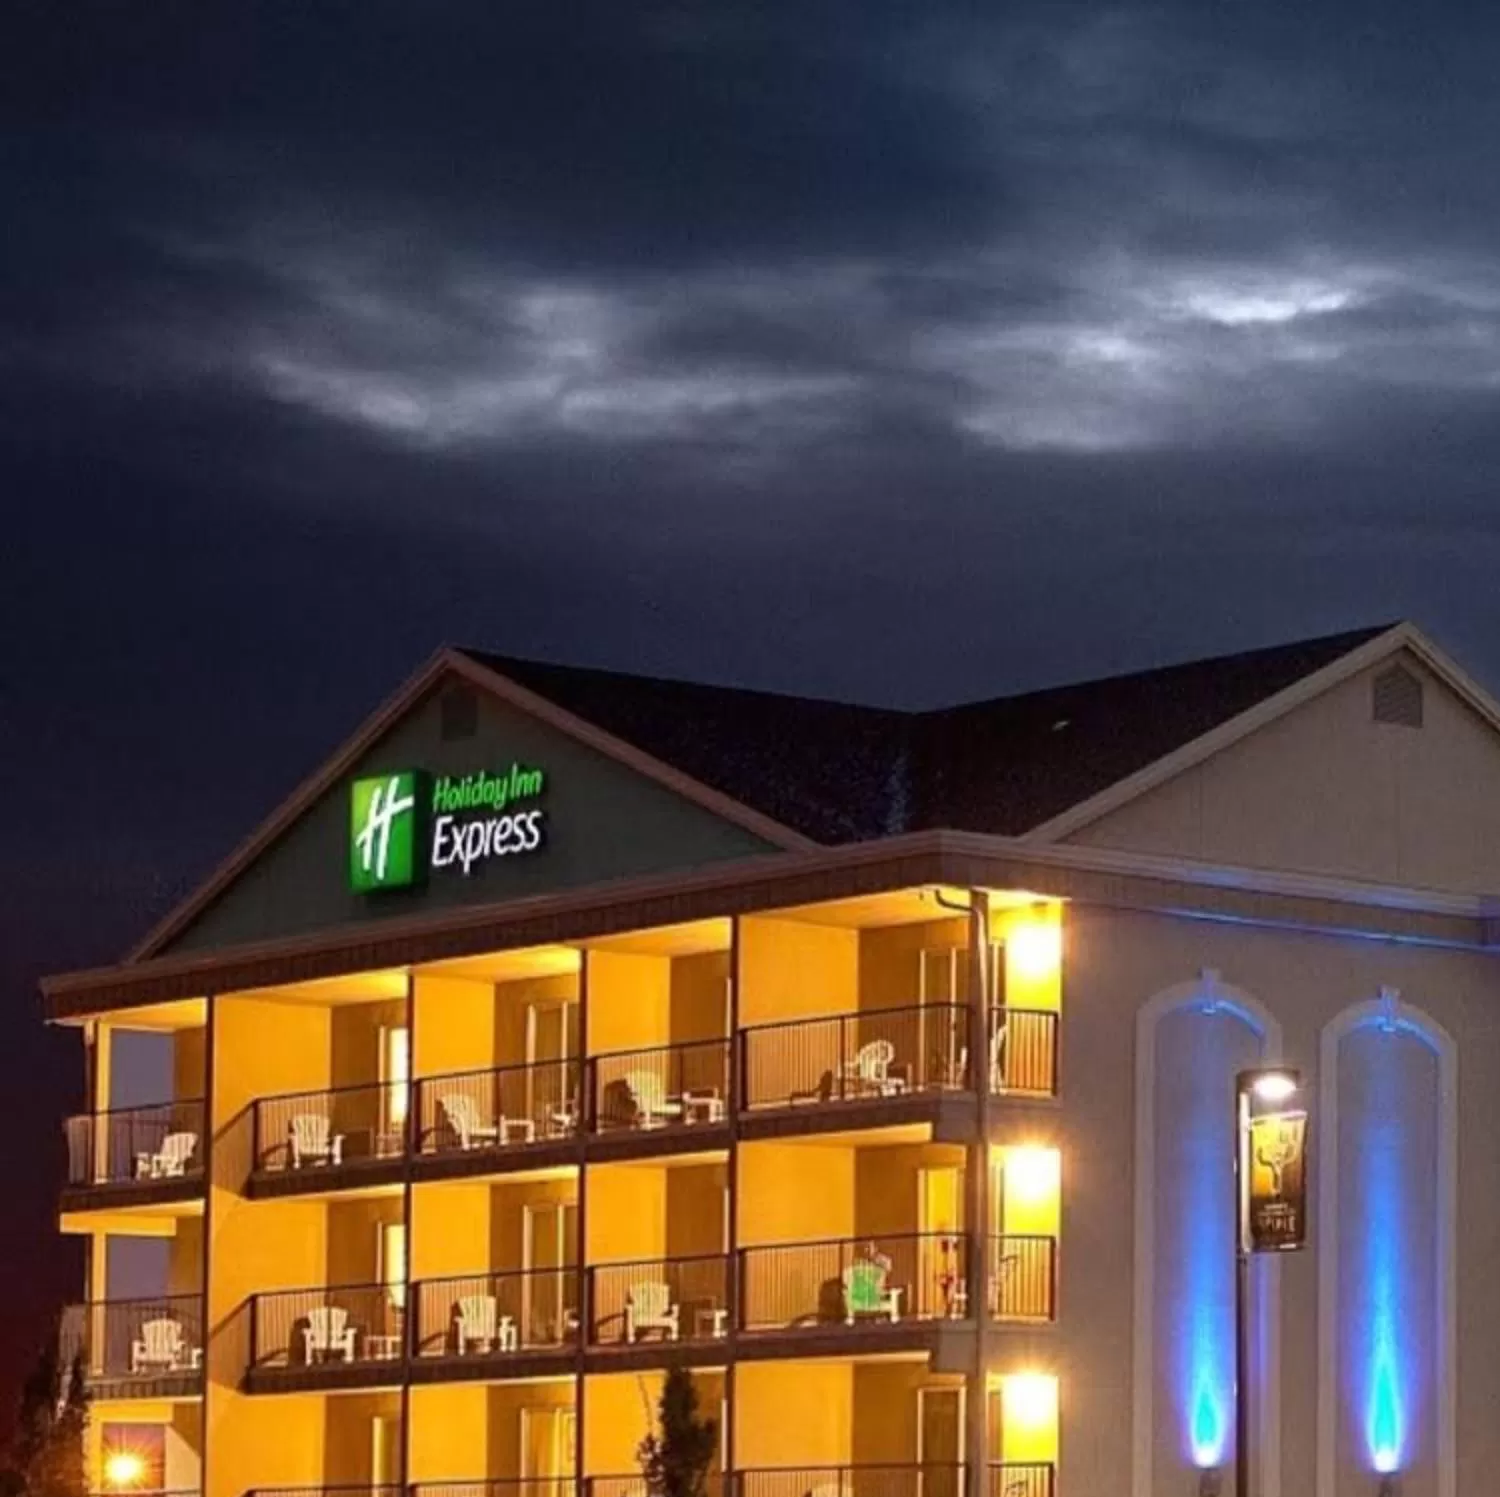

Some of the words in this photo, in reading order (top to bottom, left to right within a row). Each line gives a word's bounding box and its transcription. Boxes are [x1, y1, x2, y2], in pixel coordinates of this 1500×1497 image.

[432, 770, 507, 812] Holiday
[510, 761, 543, 799] Inn
[432, 810, 542, 874] Express
